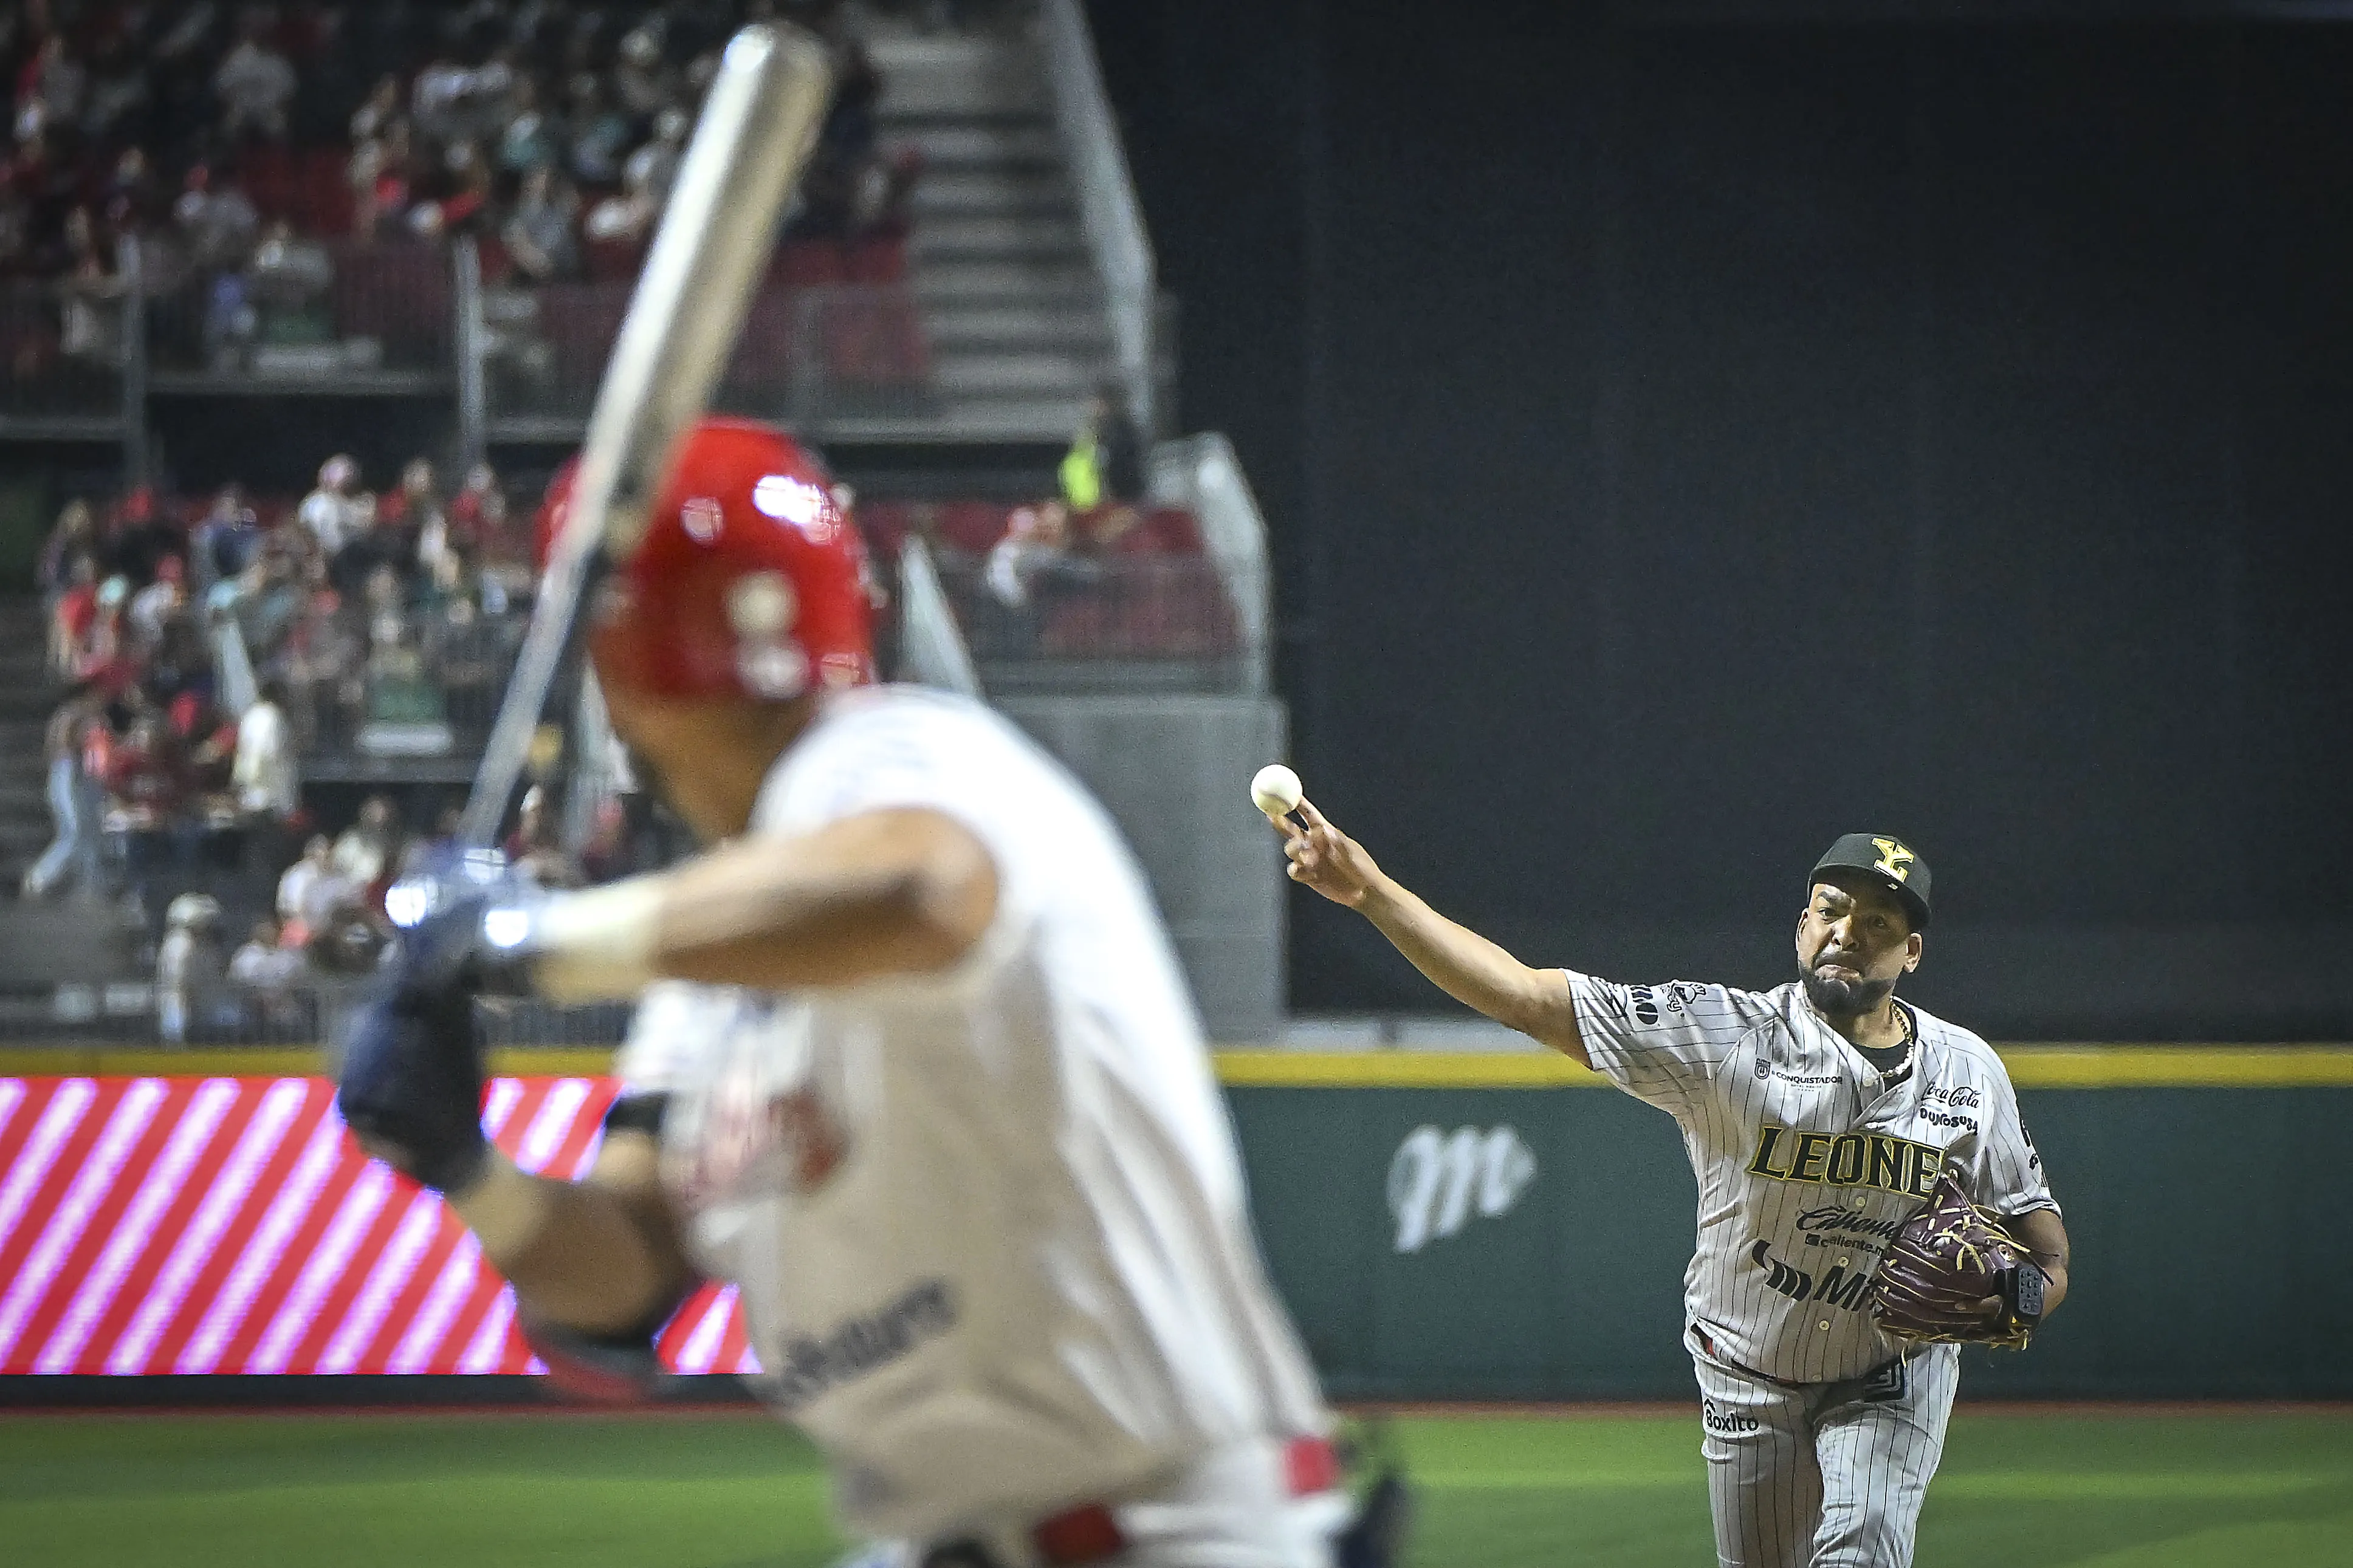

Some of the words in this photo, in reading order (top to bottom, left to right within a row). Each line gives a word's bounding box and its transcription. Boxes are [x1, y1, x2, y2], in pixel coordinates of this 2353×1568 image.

[1871, 837, 1914, 883] Y
[1776, 1072, 1843, 1084] CONQUISTADOR
[1748, 1126, 1945, 1200] LEONE
[1706, 1408, 1759, 1432] Boxito
